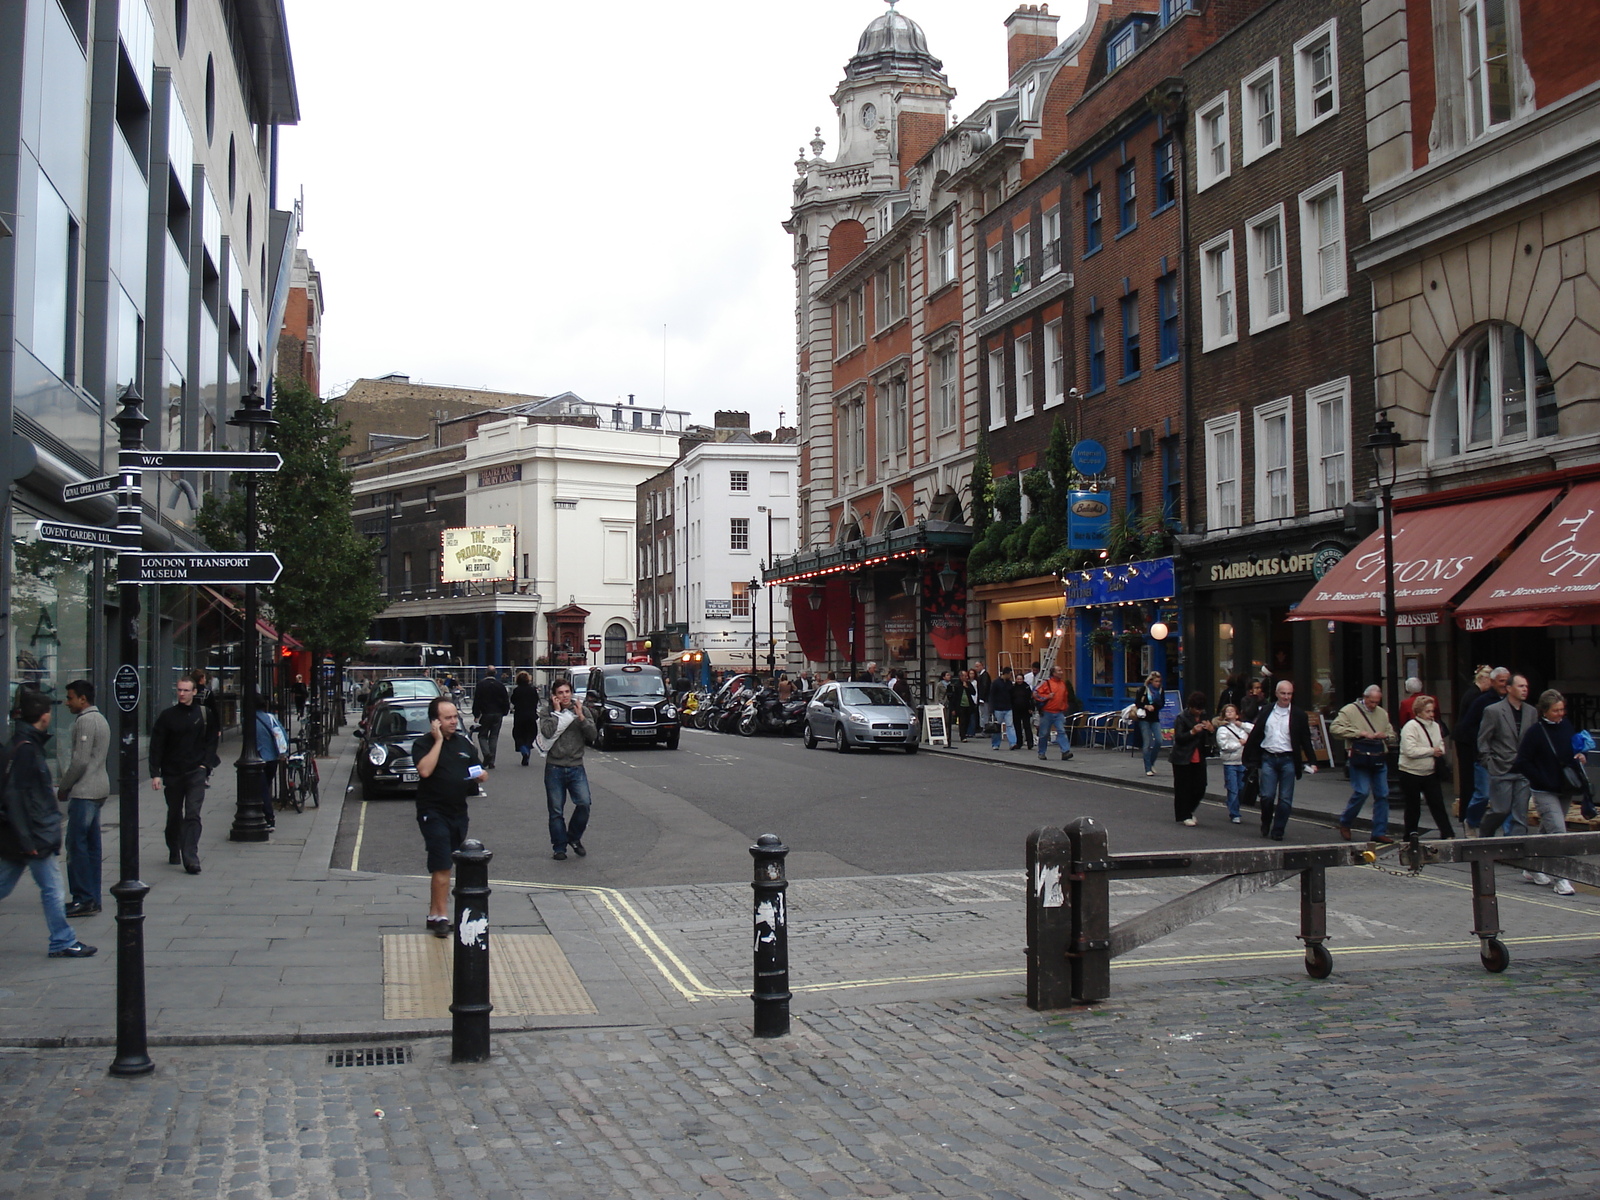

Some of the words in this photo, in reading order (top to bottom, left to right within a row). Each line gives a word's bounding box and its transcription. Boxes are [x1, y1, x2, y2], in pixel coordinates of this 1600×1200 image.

[65, 487, 79, 498] ROYAL
[80, 484, 95, 495] OPERA
[96, 480, 111, 491] HOUSE
[42, 525, 68, 538] COVENT
[69, 529, 97, 541] GARDEN
[98, 533, 112, 543] LUL
[471, 530, 486, 544] THE
[455, 544, 502, 564] PRODUCERS
[141, 558, 185, 568] LONDON
[189, 558, 251, 567] TRANSPORT
[474, 563, 490, 572] BROOKS
[1210, 557, 1279, 582] STARBUCKS
[1280, 552, 1318, 574] COFF
[141, 569, 187, 578] MUSEUM
[1315, 592, 1332, 601] The
[1331, 591, 1369, 601] Brasserie
[1411, 587, 1444, 596] corner
[1490, 589, 1510, 598] The
[1511, 584, 1561, 596] Brasserie
[1396, 612, 1439, 626] BRASSERIE
[1465, 617, 1484, 630] BAR
